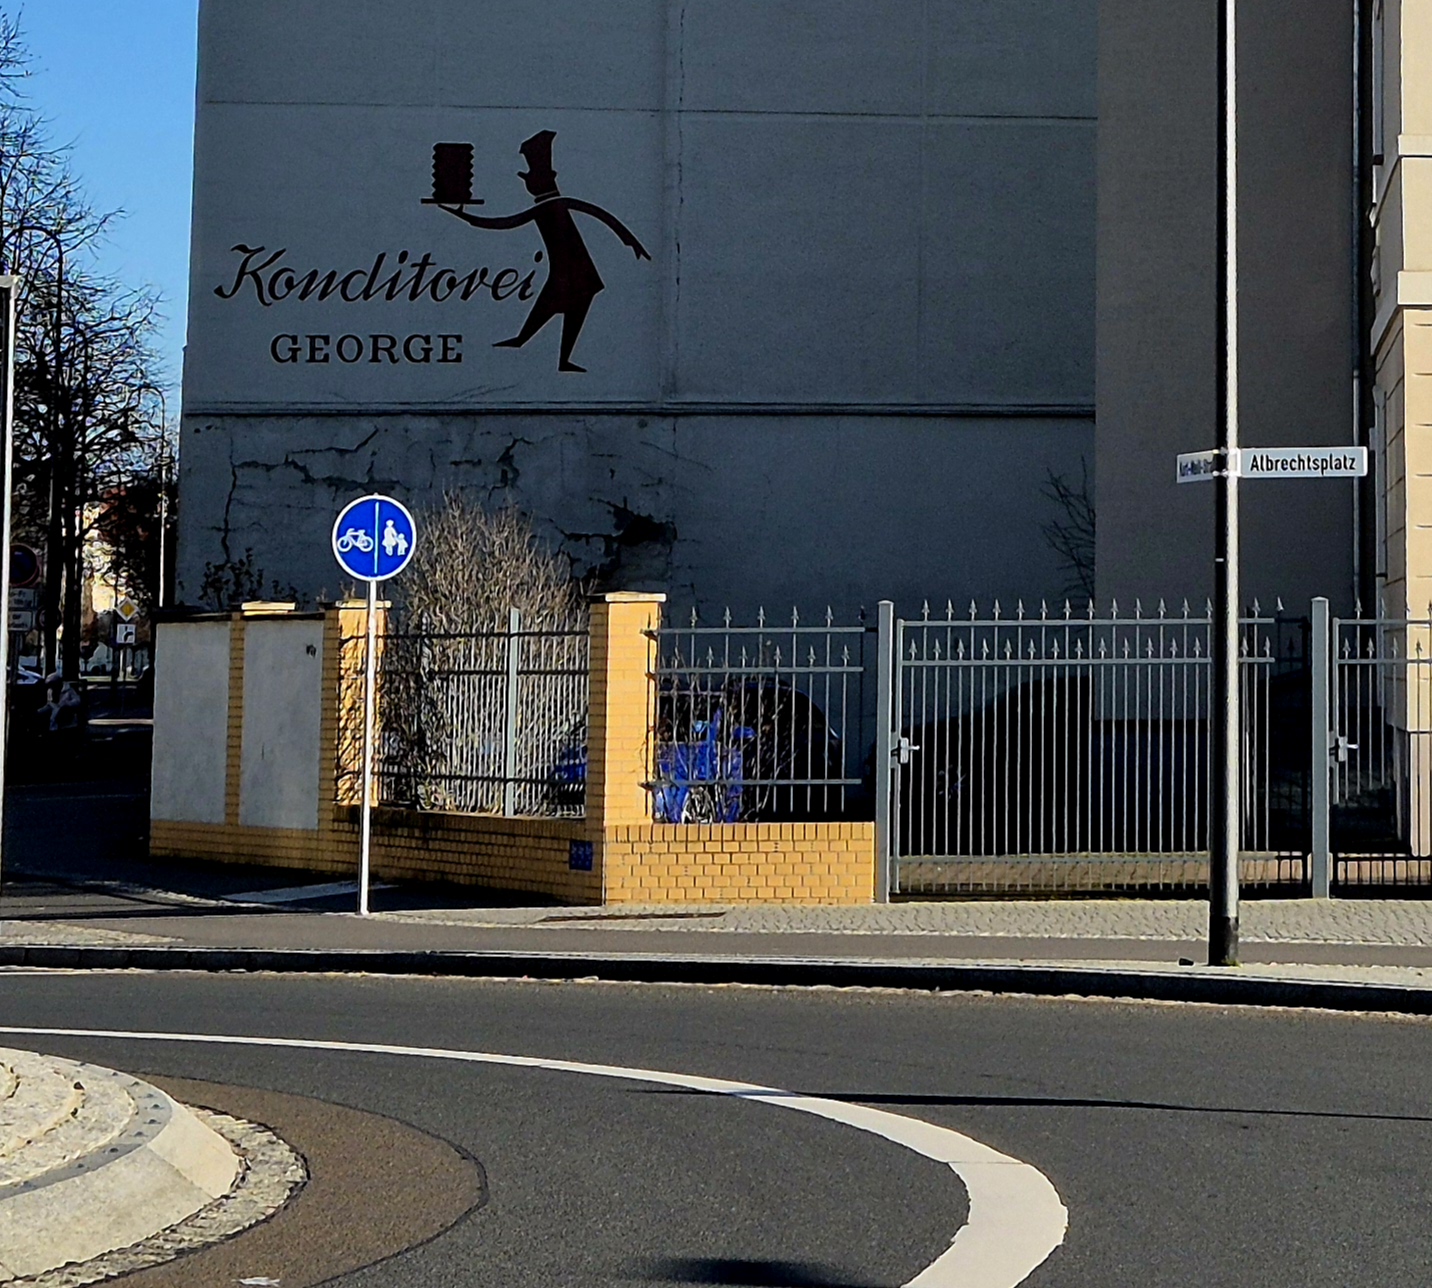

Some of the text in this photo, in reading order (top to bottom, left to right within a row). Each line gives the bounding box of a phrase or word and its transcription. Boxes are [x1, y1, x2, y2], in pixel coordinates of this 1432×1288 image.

[214, 243, 544, 307] Konditorei
[270, 333, 464, 364] GEORGE
[1250, 453, 1356, 475] Albrechtsplatz
